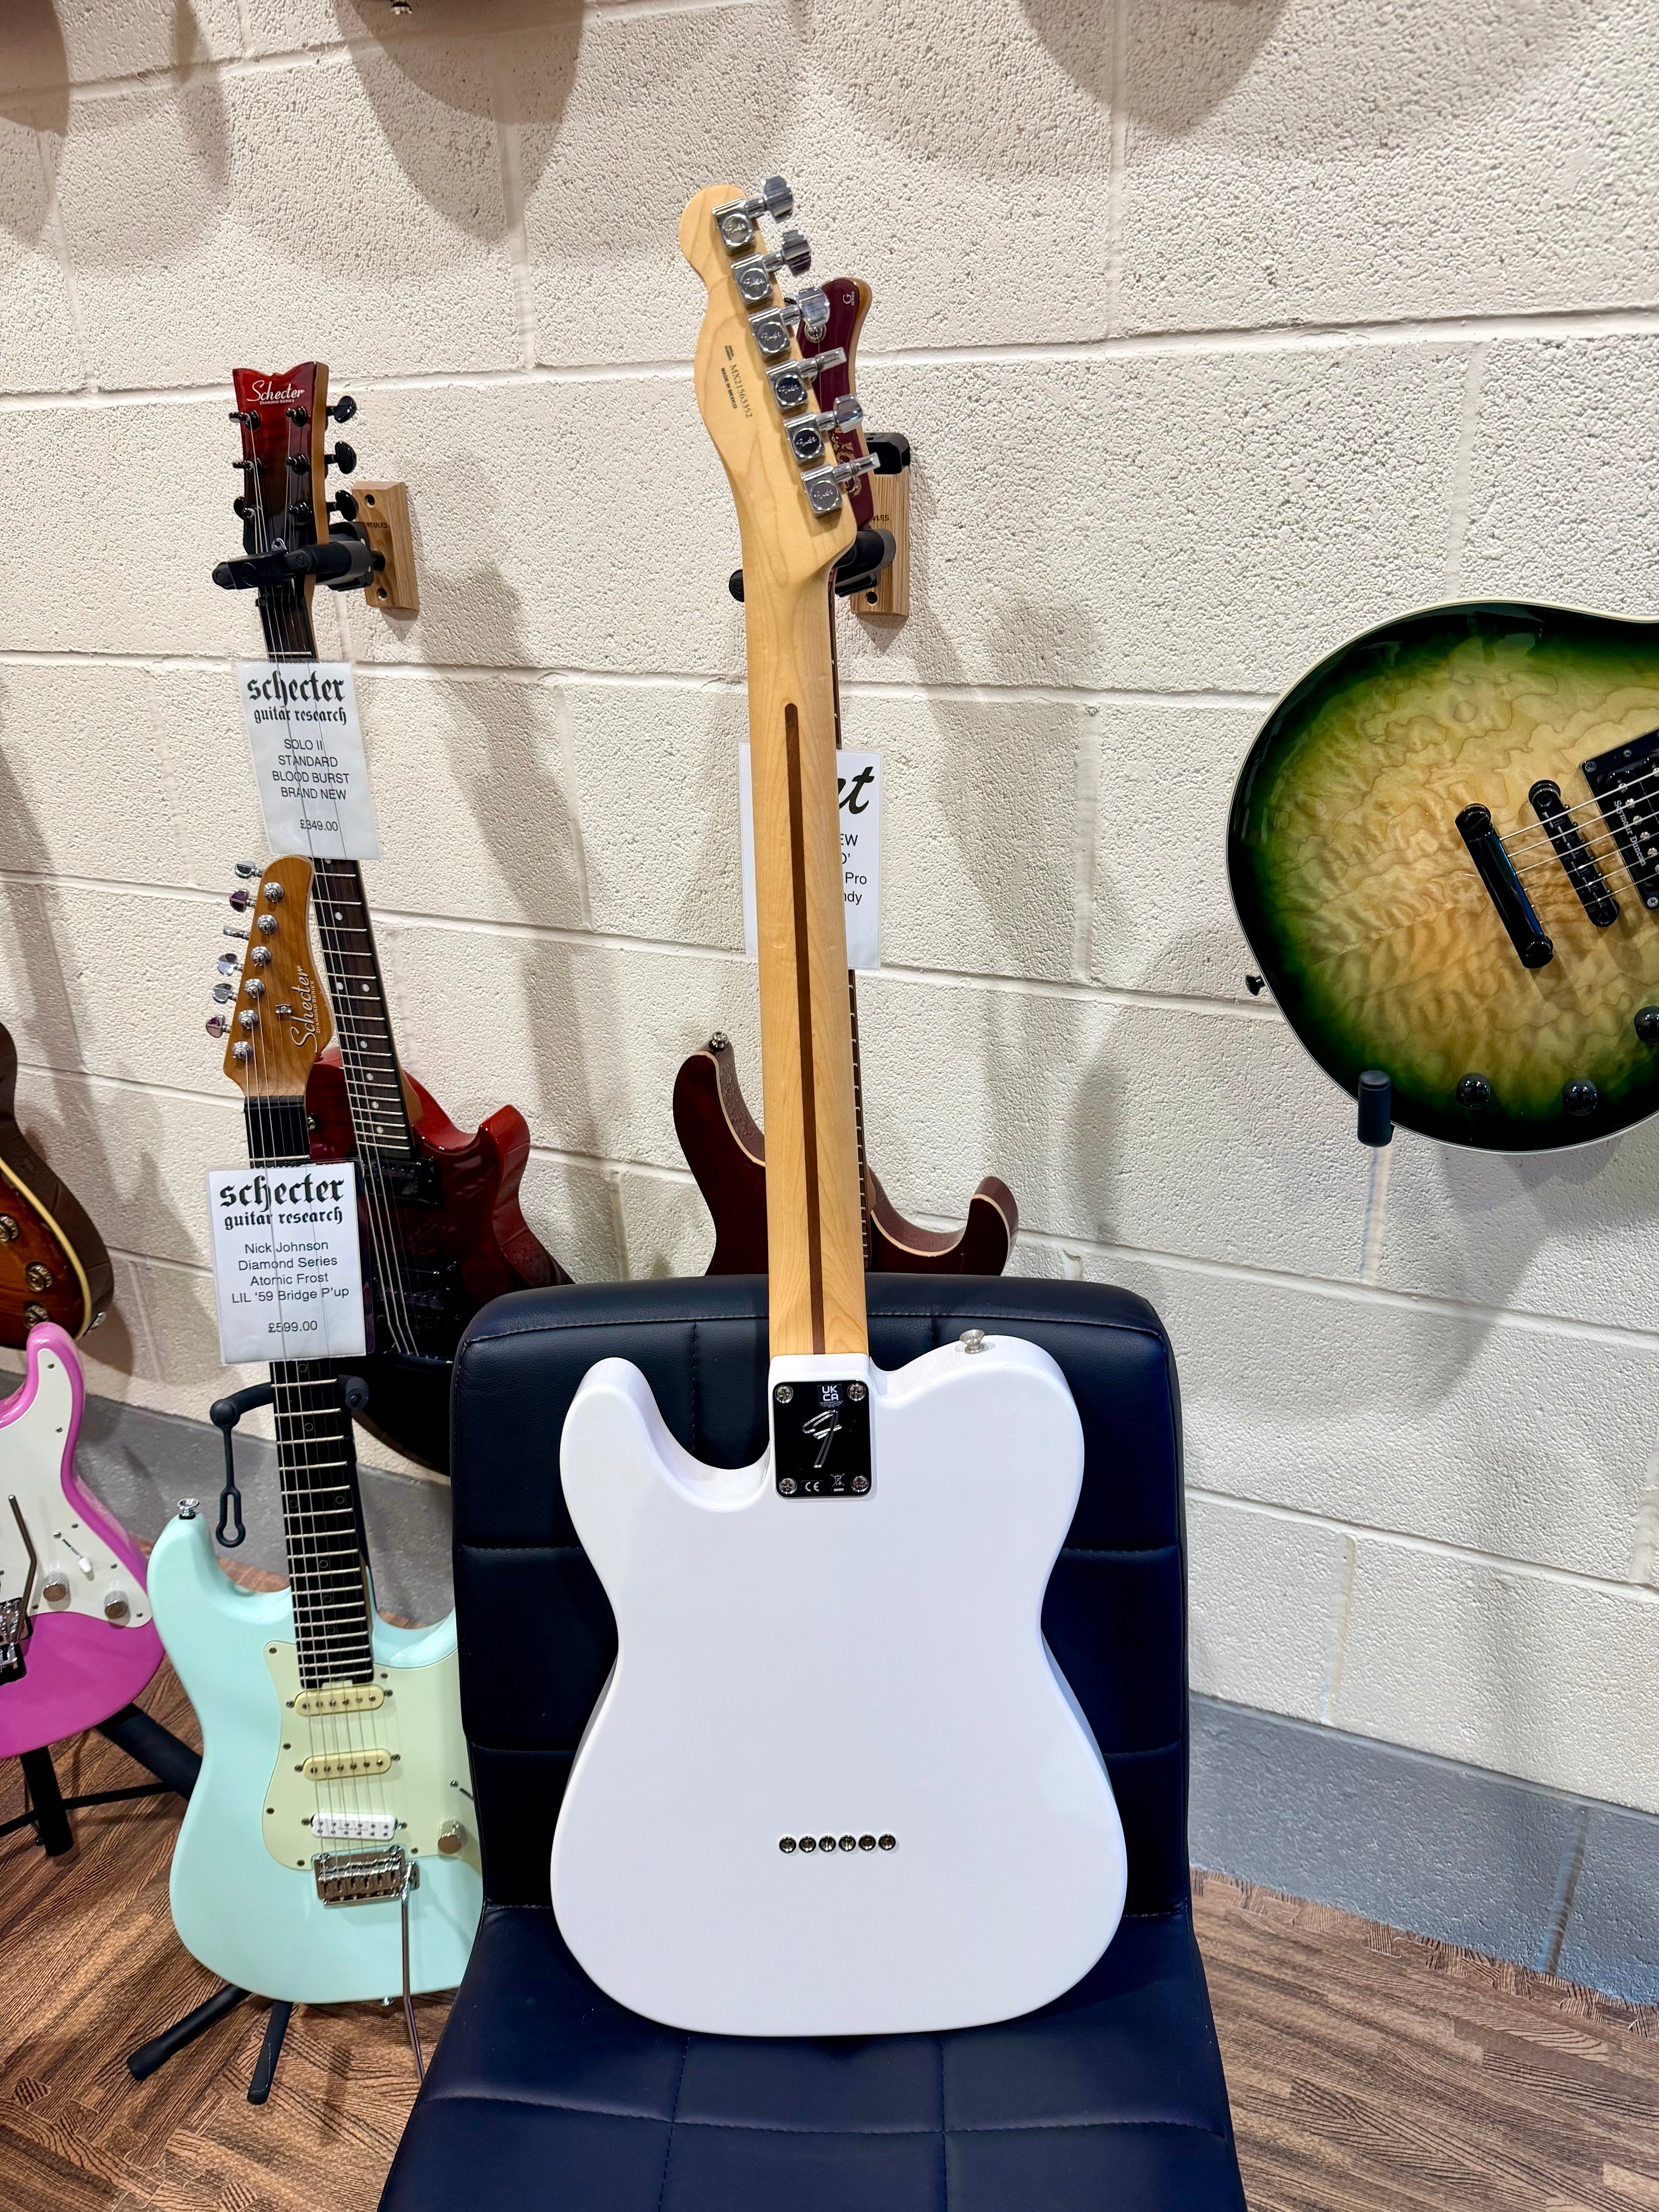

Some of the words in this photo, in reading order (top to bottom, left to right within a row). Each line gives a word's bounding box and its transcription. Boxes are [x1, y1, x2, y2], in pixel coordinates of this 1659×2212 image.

[843, 294, 851, 304] G
[247, 380, 305, 402] Schecter
[247, 670, 346, 706] schecter
[254, 706, 290, 723] guitar
[294, 706, 347, 726] research
[284, 739, 313, 750] SOLO
[317, 740, 323, 750] II
[278, 755, 338, 767] STANDARD
[272, 771, 309, 782] BLOOD
[313, 772, 350, 784] BURST
[281, 787, 318, 799] BRAND
[321, 789, 346, 800] NEW
[845, 872, 867, 885] Pro
[290, 965, 318, 1053] Schecter
[220, 1173, 344, 1212] schecter
[224, 1211, 273, 1230] guitar
[278, 1206, 343, 1224] research
[245, 1243, 272, 1254] Nick
[276, 1240, 328, 1252] Johnson
[239, 1257, 294, 1271] Diamond
[298, 1256, 338, 1267] Series
[250, 1275, 293, 1286] Atomic
[297, 1273, 328, 1284] Frost
[232, 1293, 251, 1303] LIL
[278, 1290, 318, 1302] Bridge
[268, 1320, 318, 1333] £599.00
